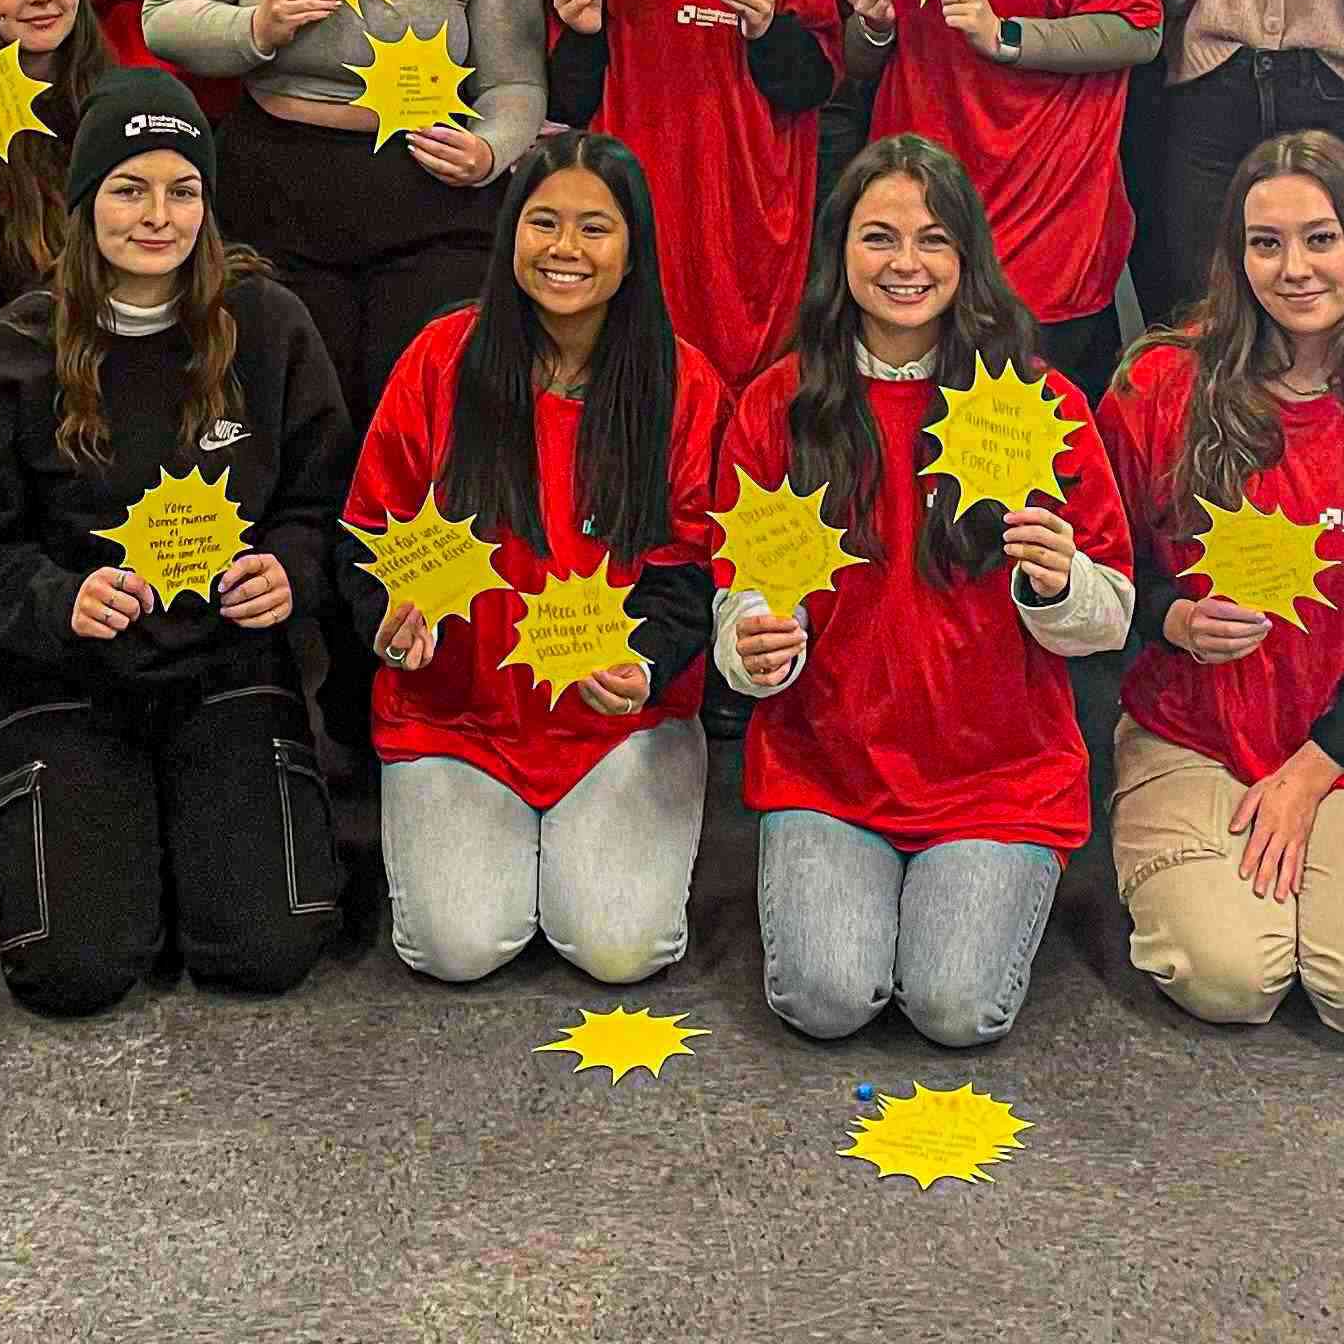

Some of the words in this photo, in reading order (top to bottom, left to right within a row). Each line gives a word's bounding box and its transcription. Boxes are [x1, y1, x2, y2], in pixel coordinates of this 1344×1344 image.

[991, 396, 1024, 418] Votre
[164, 503, 193, 515] Votre
[536, 601, 578, 621] Merci
[582, 602, 601, 617] de
[527, 623, 589, 645] partager
[596, 619, 628, 635] votre
[535, 639, 594, 661] passion
